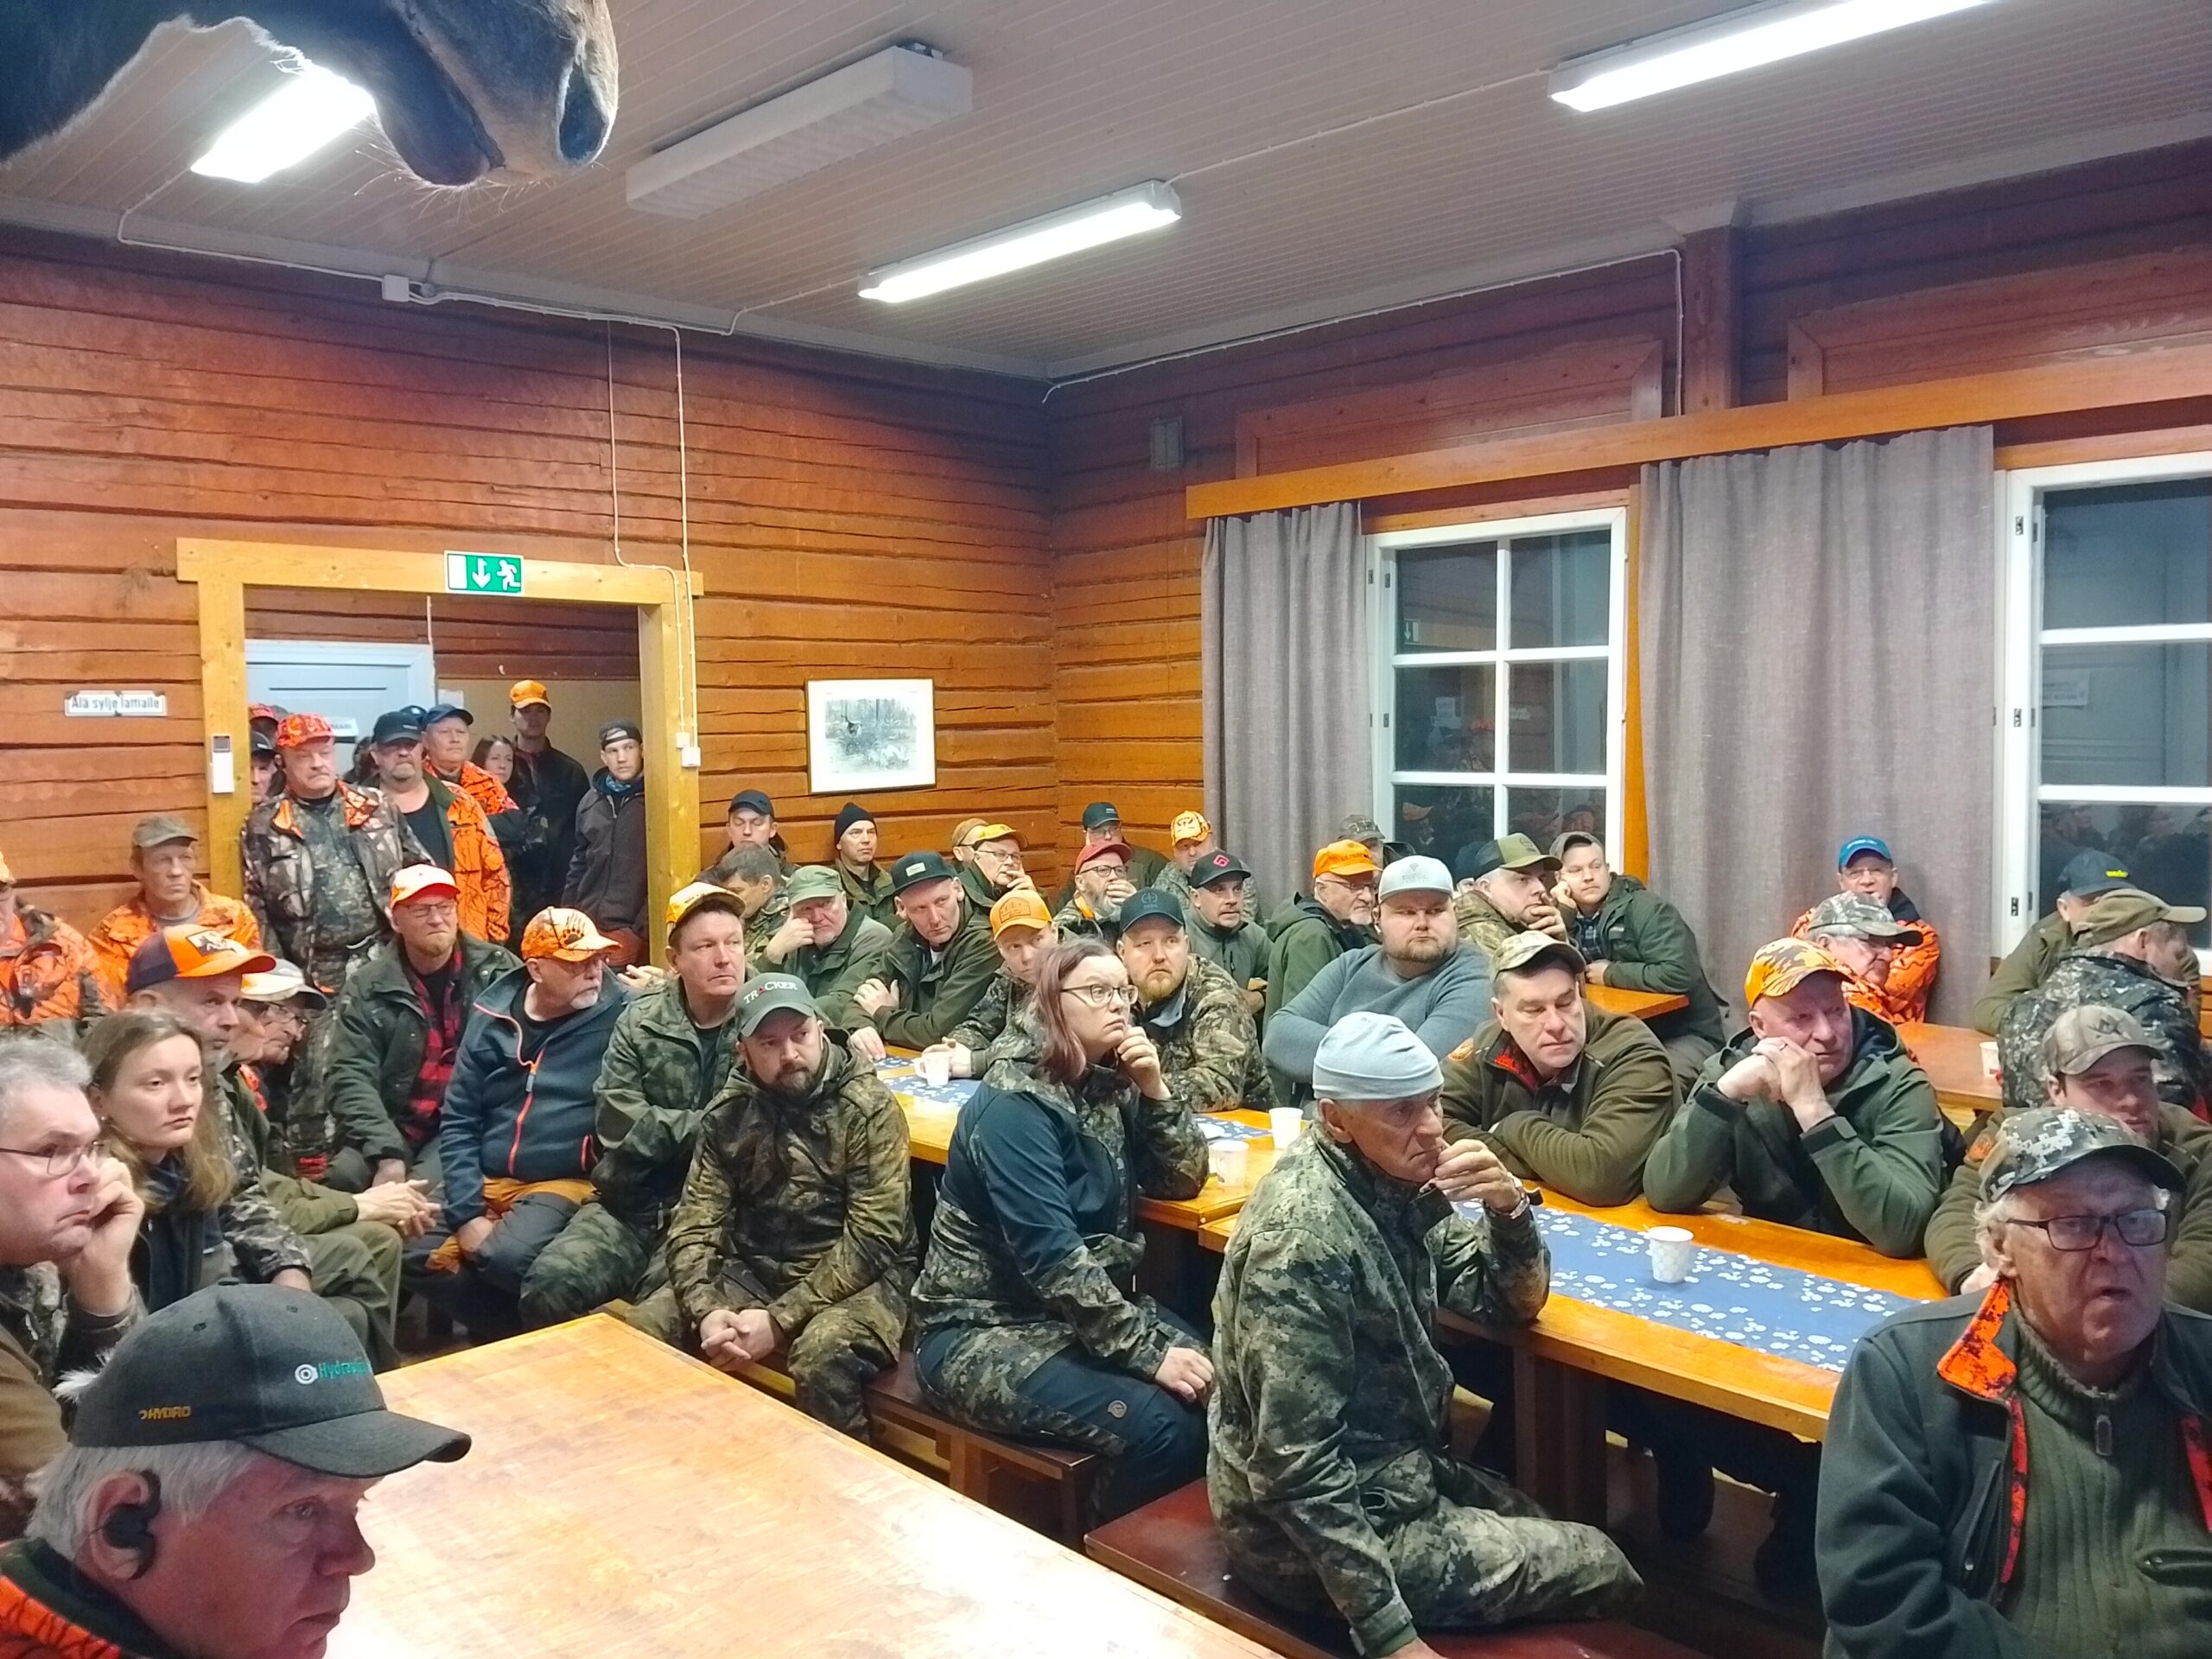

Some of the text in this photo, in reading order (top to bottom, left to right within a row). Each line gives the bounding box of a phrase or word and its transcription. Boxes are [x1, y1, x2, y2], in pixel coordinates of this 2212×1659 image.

[92, 696, 118, 711] sylje
[120, 696, 160, 709] lattialle
[742, 981, 798, 1004] TRACKER
